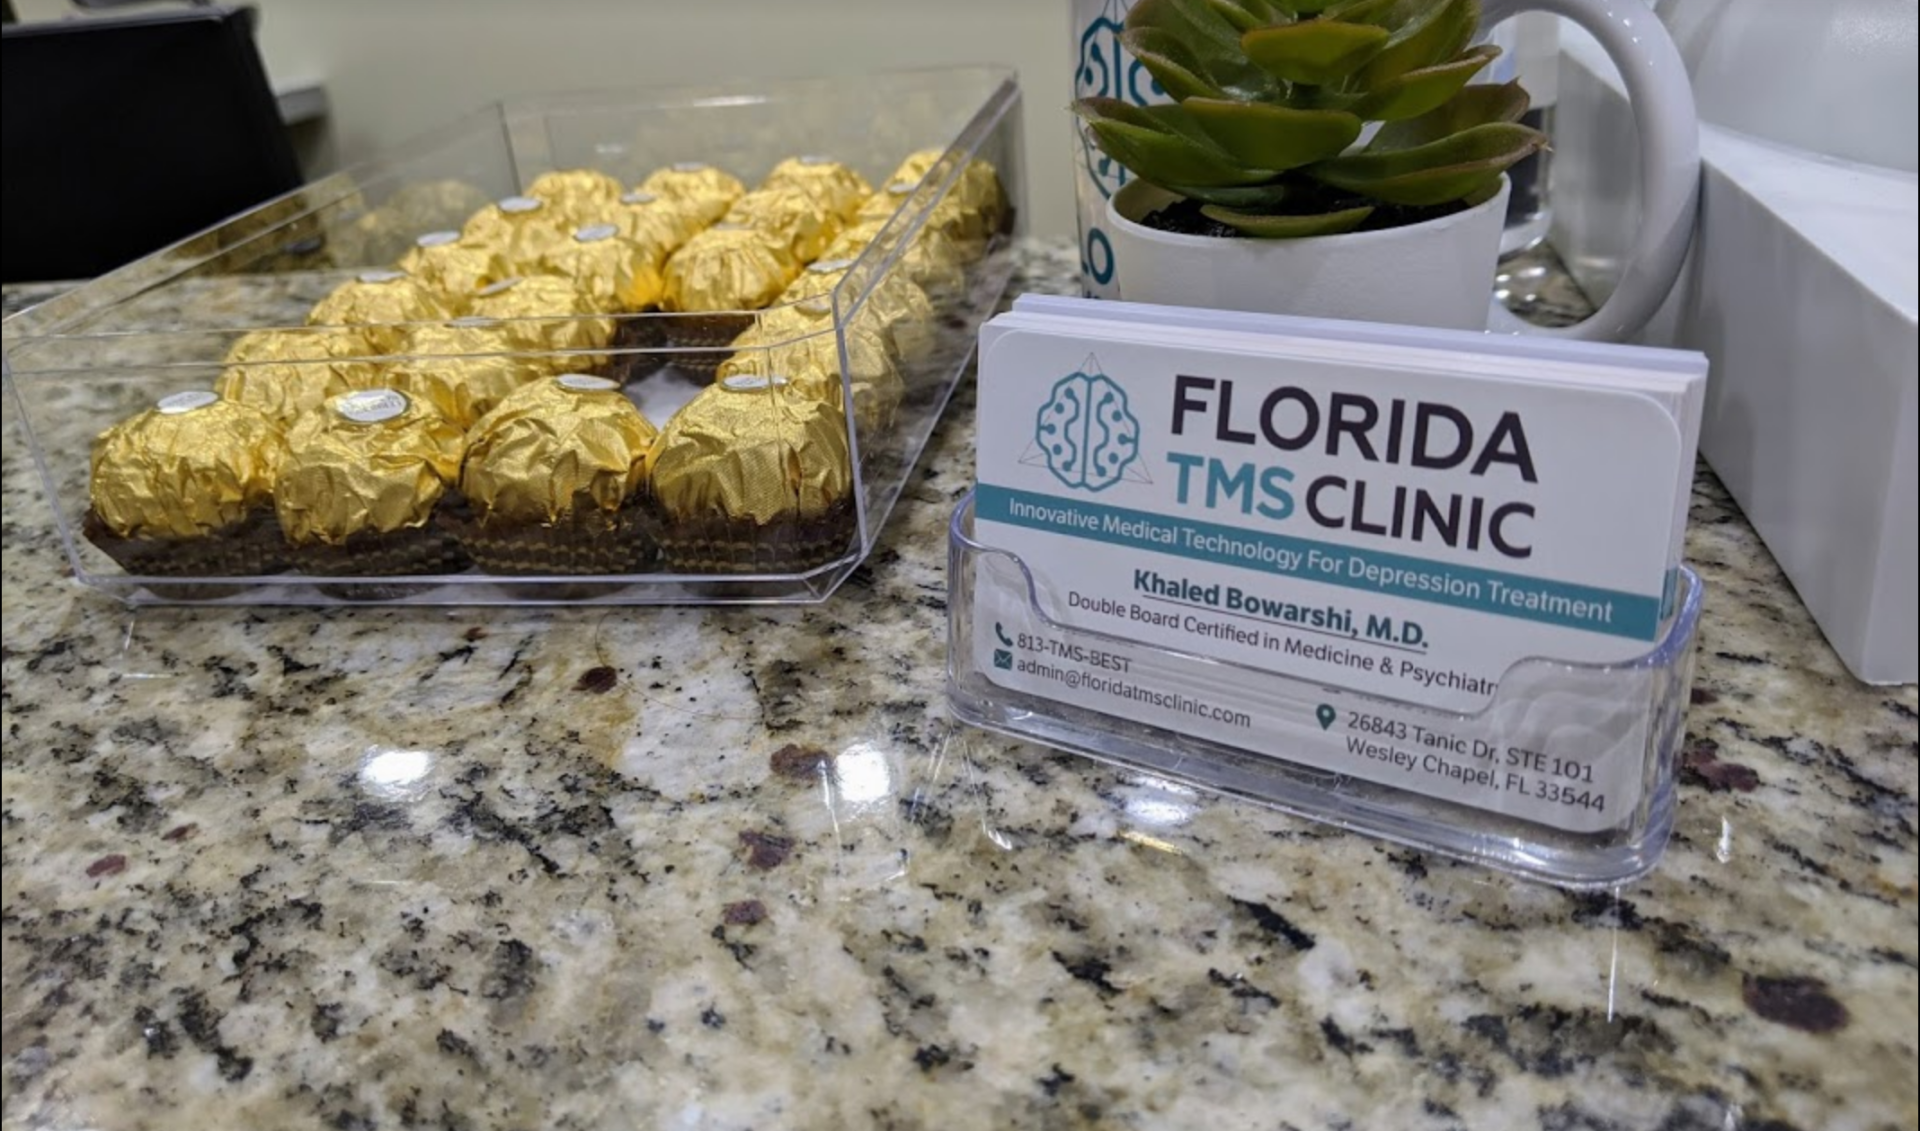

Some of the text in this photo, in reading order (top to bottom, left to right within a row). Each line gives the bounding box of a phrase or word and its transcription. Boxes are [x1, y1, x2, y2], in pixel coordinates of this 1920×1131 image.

[1171, 374, 1538, 483] FLORIDA
[1167, 451, 1536, 559] TMS CLINIC
[1009, 497, 1613, 622] Innovative Medical Technology For Depression Treatment
[1068, 591, 1499, 696] Double Board Certified in Medicine & Psychiatr
[1133, 568, 1429, 648] Khaled Bowarshi, M.D.
[1017, 633, 1133, 673] 813-TMS-BEST
[1017, 658, 1251, 728] admin@floridatmsclinic.com
[1346, 735, 1606, 812] Wesley Chapel, FL 33544
[1347, 711, 1407, 740] 26843
[1412, 725, 1467, 754] Tanic
[1505, 747, 1547, 772] STE
[1552, 757, 1593, 783] 101
